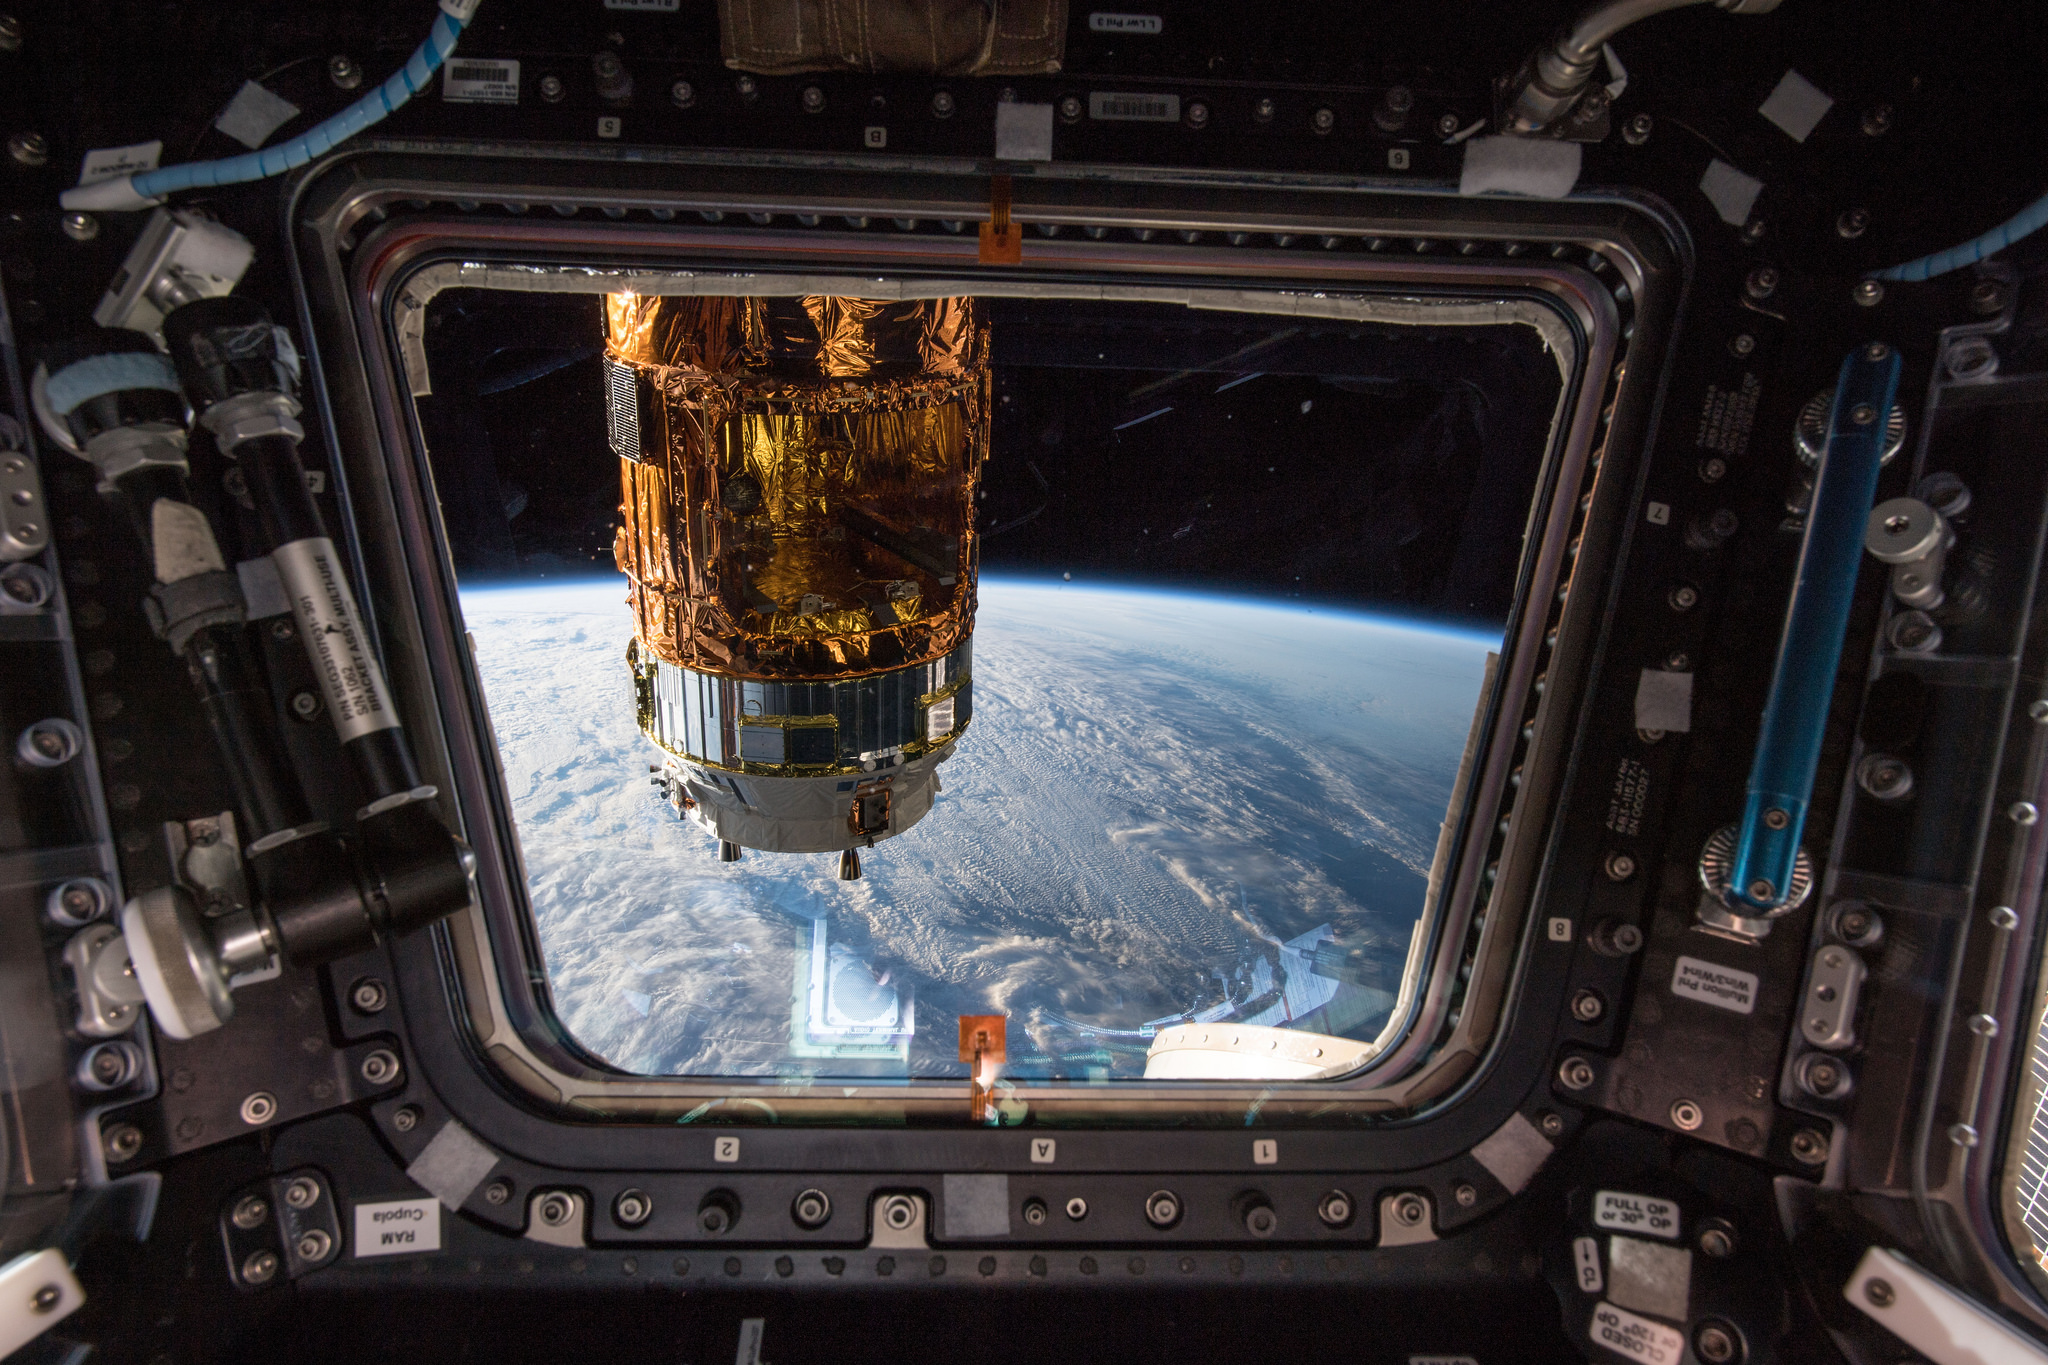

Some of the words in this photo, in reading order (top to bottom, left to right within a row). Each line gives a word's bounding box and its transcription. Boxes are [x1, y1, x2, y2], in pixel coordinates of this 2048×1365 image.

[1097, 17, 1104, 27] 3
[1106, 17, 1123, 27] Pnl
[1126, 18, 1146, 28] Lwr
[1149, 19, 1155, 28] L
[604, 120, 614, 133] 5
[870, 130, 881, 143] B
[1653, 506, 1663, 520] 7
[314, 554, 347, 618] MULTI-USE
[341, 667, 358, 694] 1062
[352, 655, 382, 713] BRACKET
[338, 704, 354, 721] P/N
[352, 698, 370, 717] S/N
[1555, 922, 1565, 936] 8
[1678, 976, 1699, 991] Pnl
[1702, 983, 1749, 1004] Mullion
[722, 1142, 732, 1157] 2
[1037, 1143, 1050, 1156] A
[1605, 1197, 1643, 1213] FULL
[1647, 1203, 1669, 1216] OP
[373, 1207, 423, 1224] Cupola
[1602, 1210, 1617, 1221] or
[1650, 1216, 1672, 1229] OP
[381, 1230, 415, 1245] RAM
[1583, 1267, 1596, 1287] CL
[1597, 1311, 1619, 1328] OP
[1601, 1327, 1666, 1363] CLOSED
